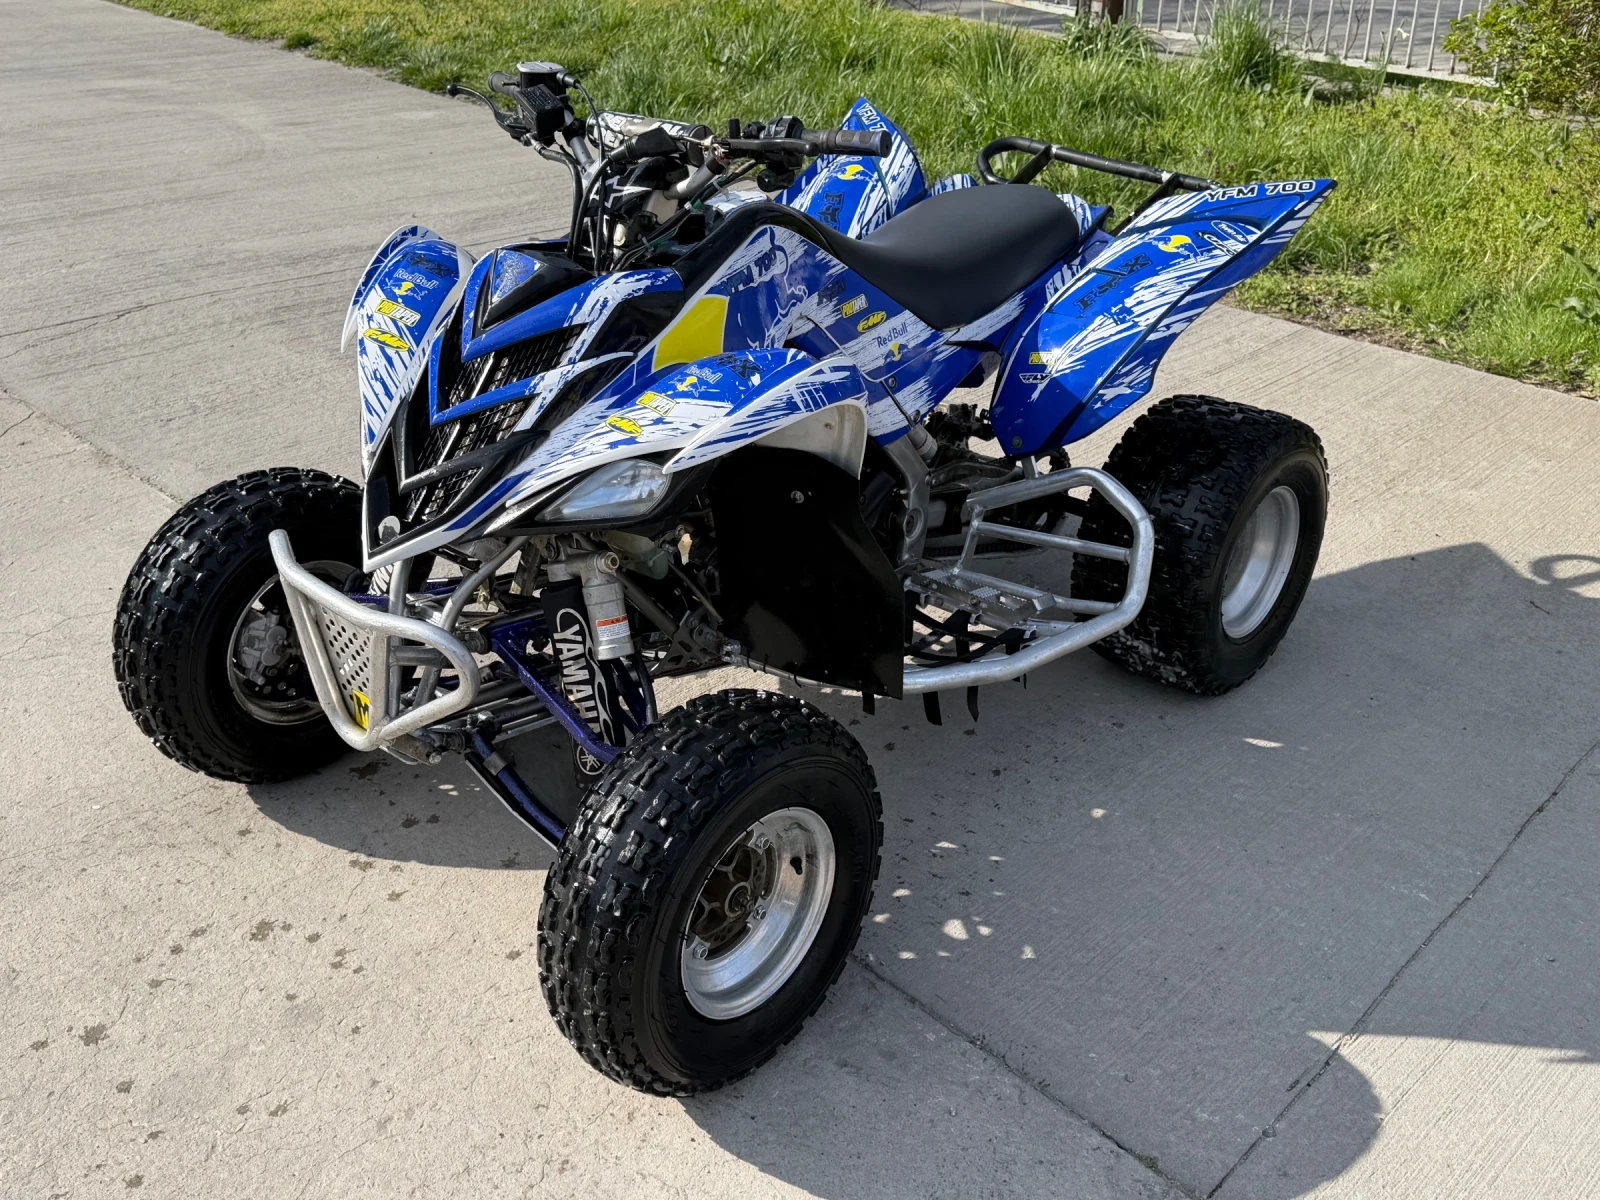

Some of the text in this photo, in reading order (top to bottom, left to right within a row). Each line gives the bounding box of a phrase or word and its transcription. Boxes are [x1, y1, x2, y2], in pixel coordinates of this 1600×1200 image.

[856, 102, 880, 125] YFM
[1206, 180, 1316, 202] YFM 700
[754, 247, 777, 278] 700
[858, 311, 886, 332] FMF
[876, 322, 908, 348] Red Bull
